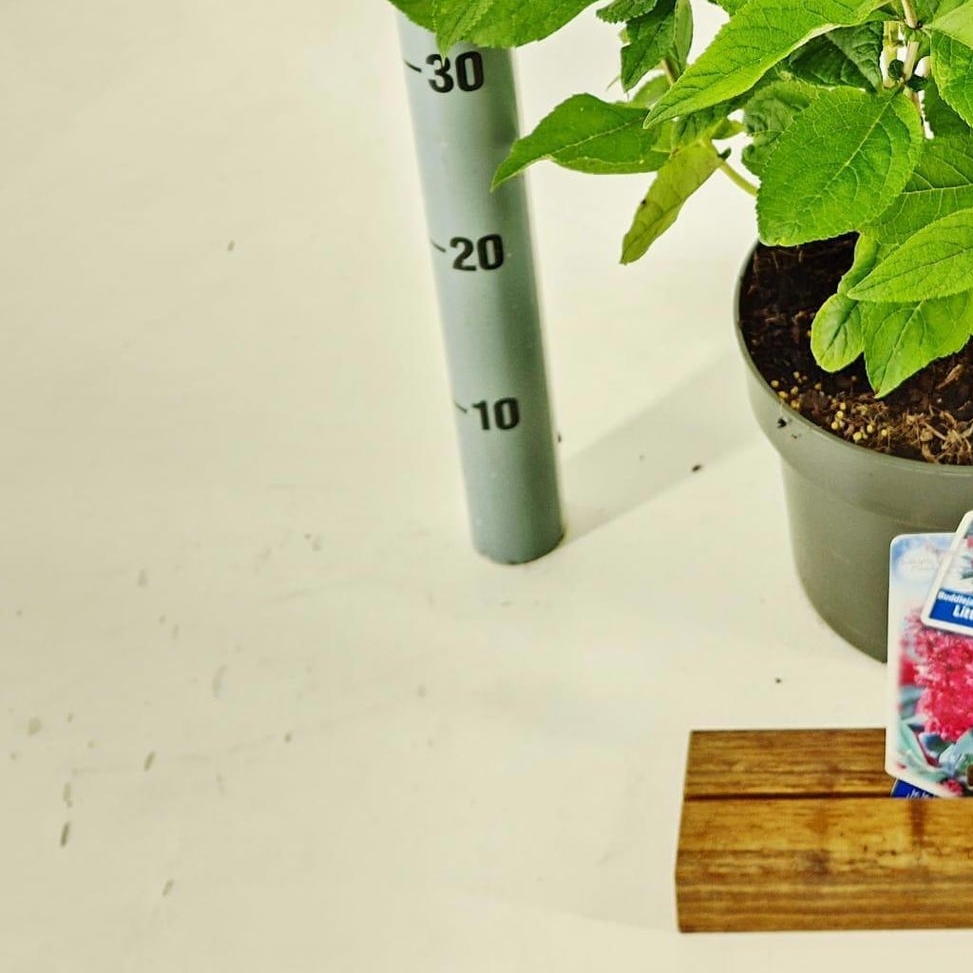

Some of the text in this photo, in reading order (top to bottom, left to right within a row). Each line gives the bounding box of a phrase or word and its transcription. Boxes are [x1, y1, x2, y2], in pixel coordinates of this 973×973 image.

[426, 51, 484, 93] 30
[450, 234, 505, 271] 20
[472, 398, 520, 431] 10
